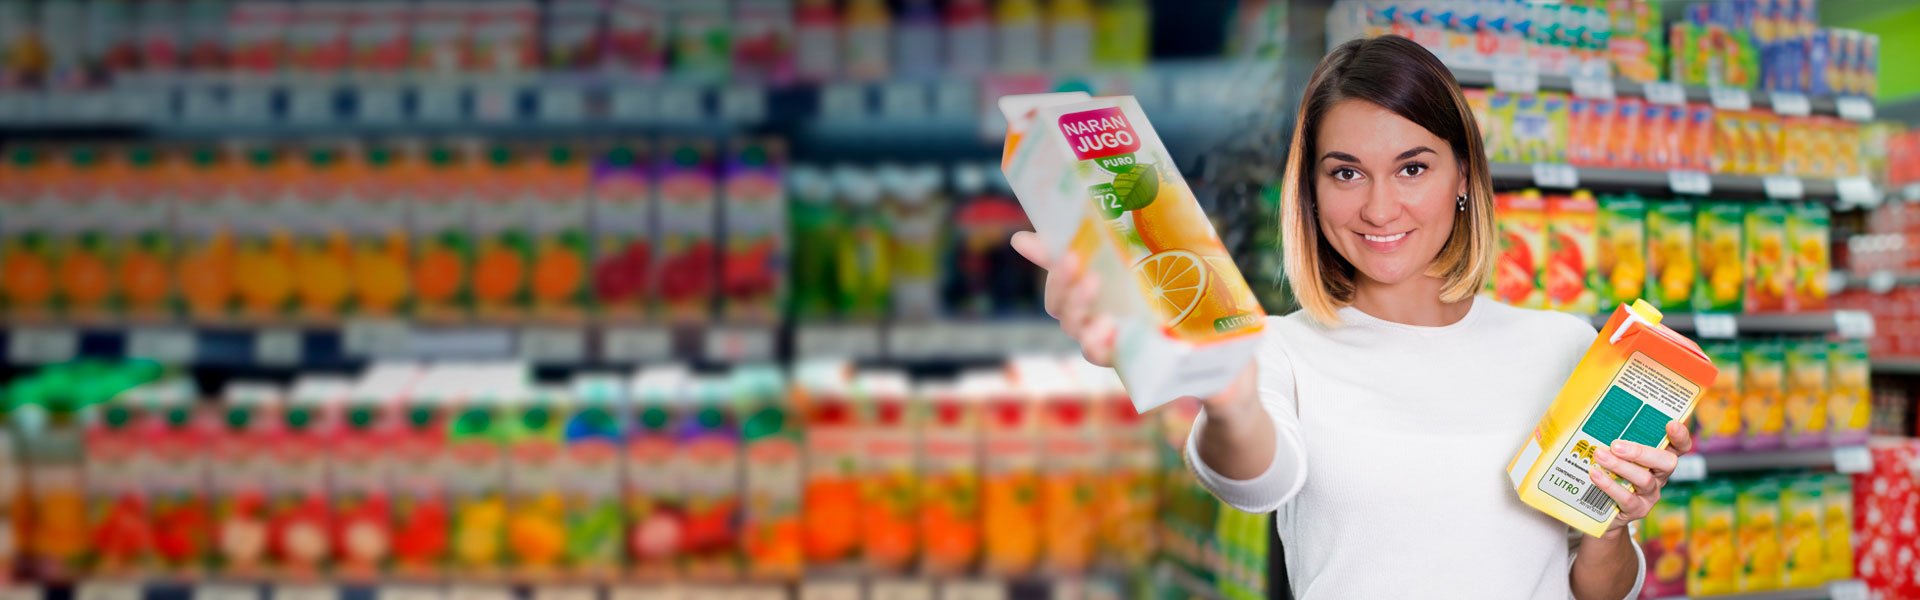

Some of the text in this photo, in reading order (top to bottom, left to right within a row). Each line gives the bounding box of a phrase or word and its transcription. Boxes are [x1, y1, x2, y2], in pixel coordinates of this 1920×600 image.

[1062, 115, 1127, 137] NARAN
[1077, 130, 1134, 153] JUGO
[1102, 156, 1134, 168] PURO
[1094, 193, 1122, 211] 72
[1218, 315, 1256, 329] 1 LITRO
[1548, 474, 1580, 495] 1 LITRO
